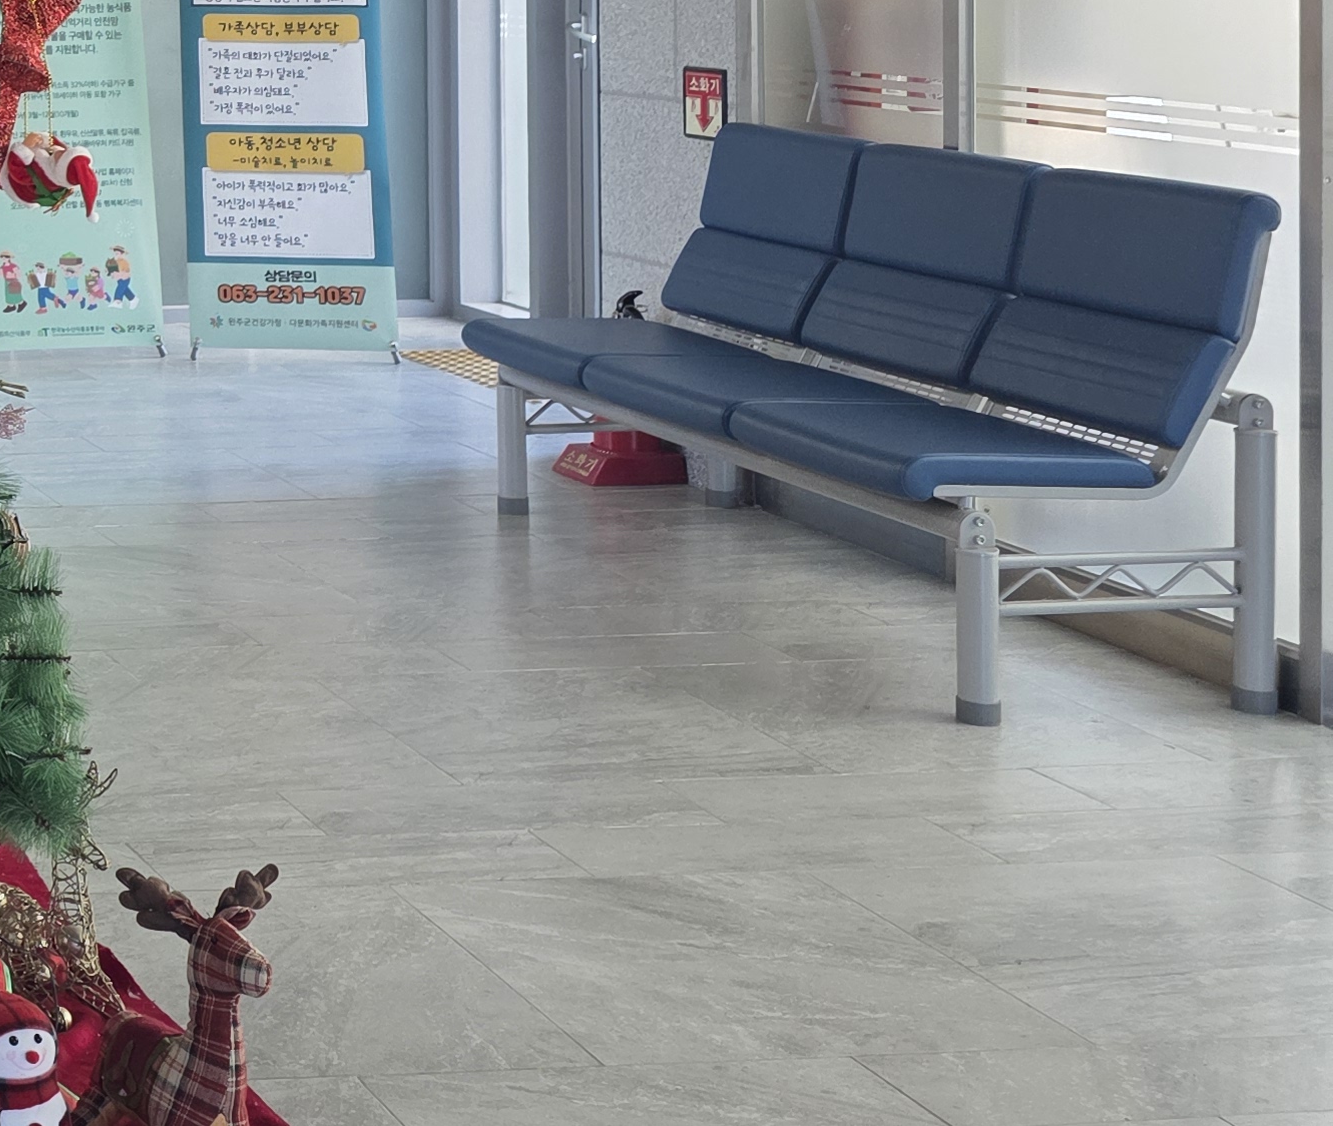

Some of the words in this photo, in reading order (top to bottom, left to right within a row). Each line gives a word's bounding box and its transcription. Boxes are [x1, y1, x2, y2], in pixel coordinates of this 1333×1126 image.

[106, 2, 131, 12] 농식품
[217, 20, 279, 37] 가족상담,
[283, 21, 340, 36] 부부상담
[69, 30, 93, 41] 구매할
[95, 30, 103, 40] 수
[105, 30, 123, 41] 있는
[55, 44, 99, 55] 지원합니다.
[243, 50, 271, 61] 대화가
[233, 68, 253, 78] 전과
[257, 68, 274, 78] 후가
[689, 76, 719, 94] 소화기
[235, 102, 264, 114] 폭력이
[229, 136, 301, 152] 아동,청소년
[306, 136, 337, 152] 상담
[289, 156, 333, 168] 놀이치료
[247, 180, 295, 192] 폭력적이고
[297, 182, 317, 192] 화가
[240, 235, 259, 246] 너무
[261, 235, 271, 246] 안
[264, 270, 317, 283] 상담문의
[218, 284, 366, 306] 063-231-1037
[127, 324, 157, 334] 완주군
